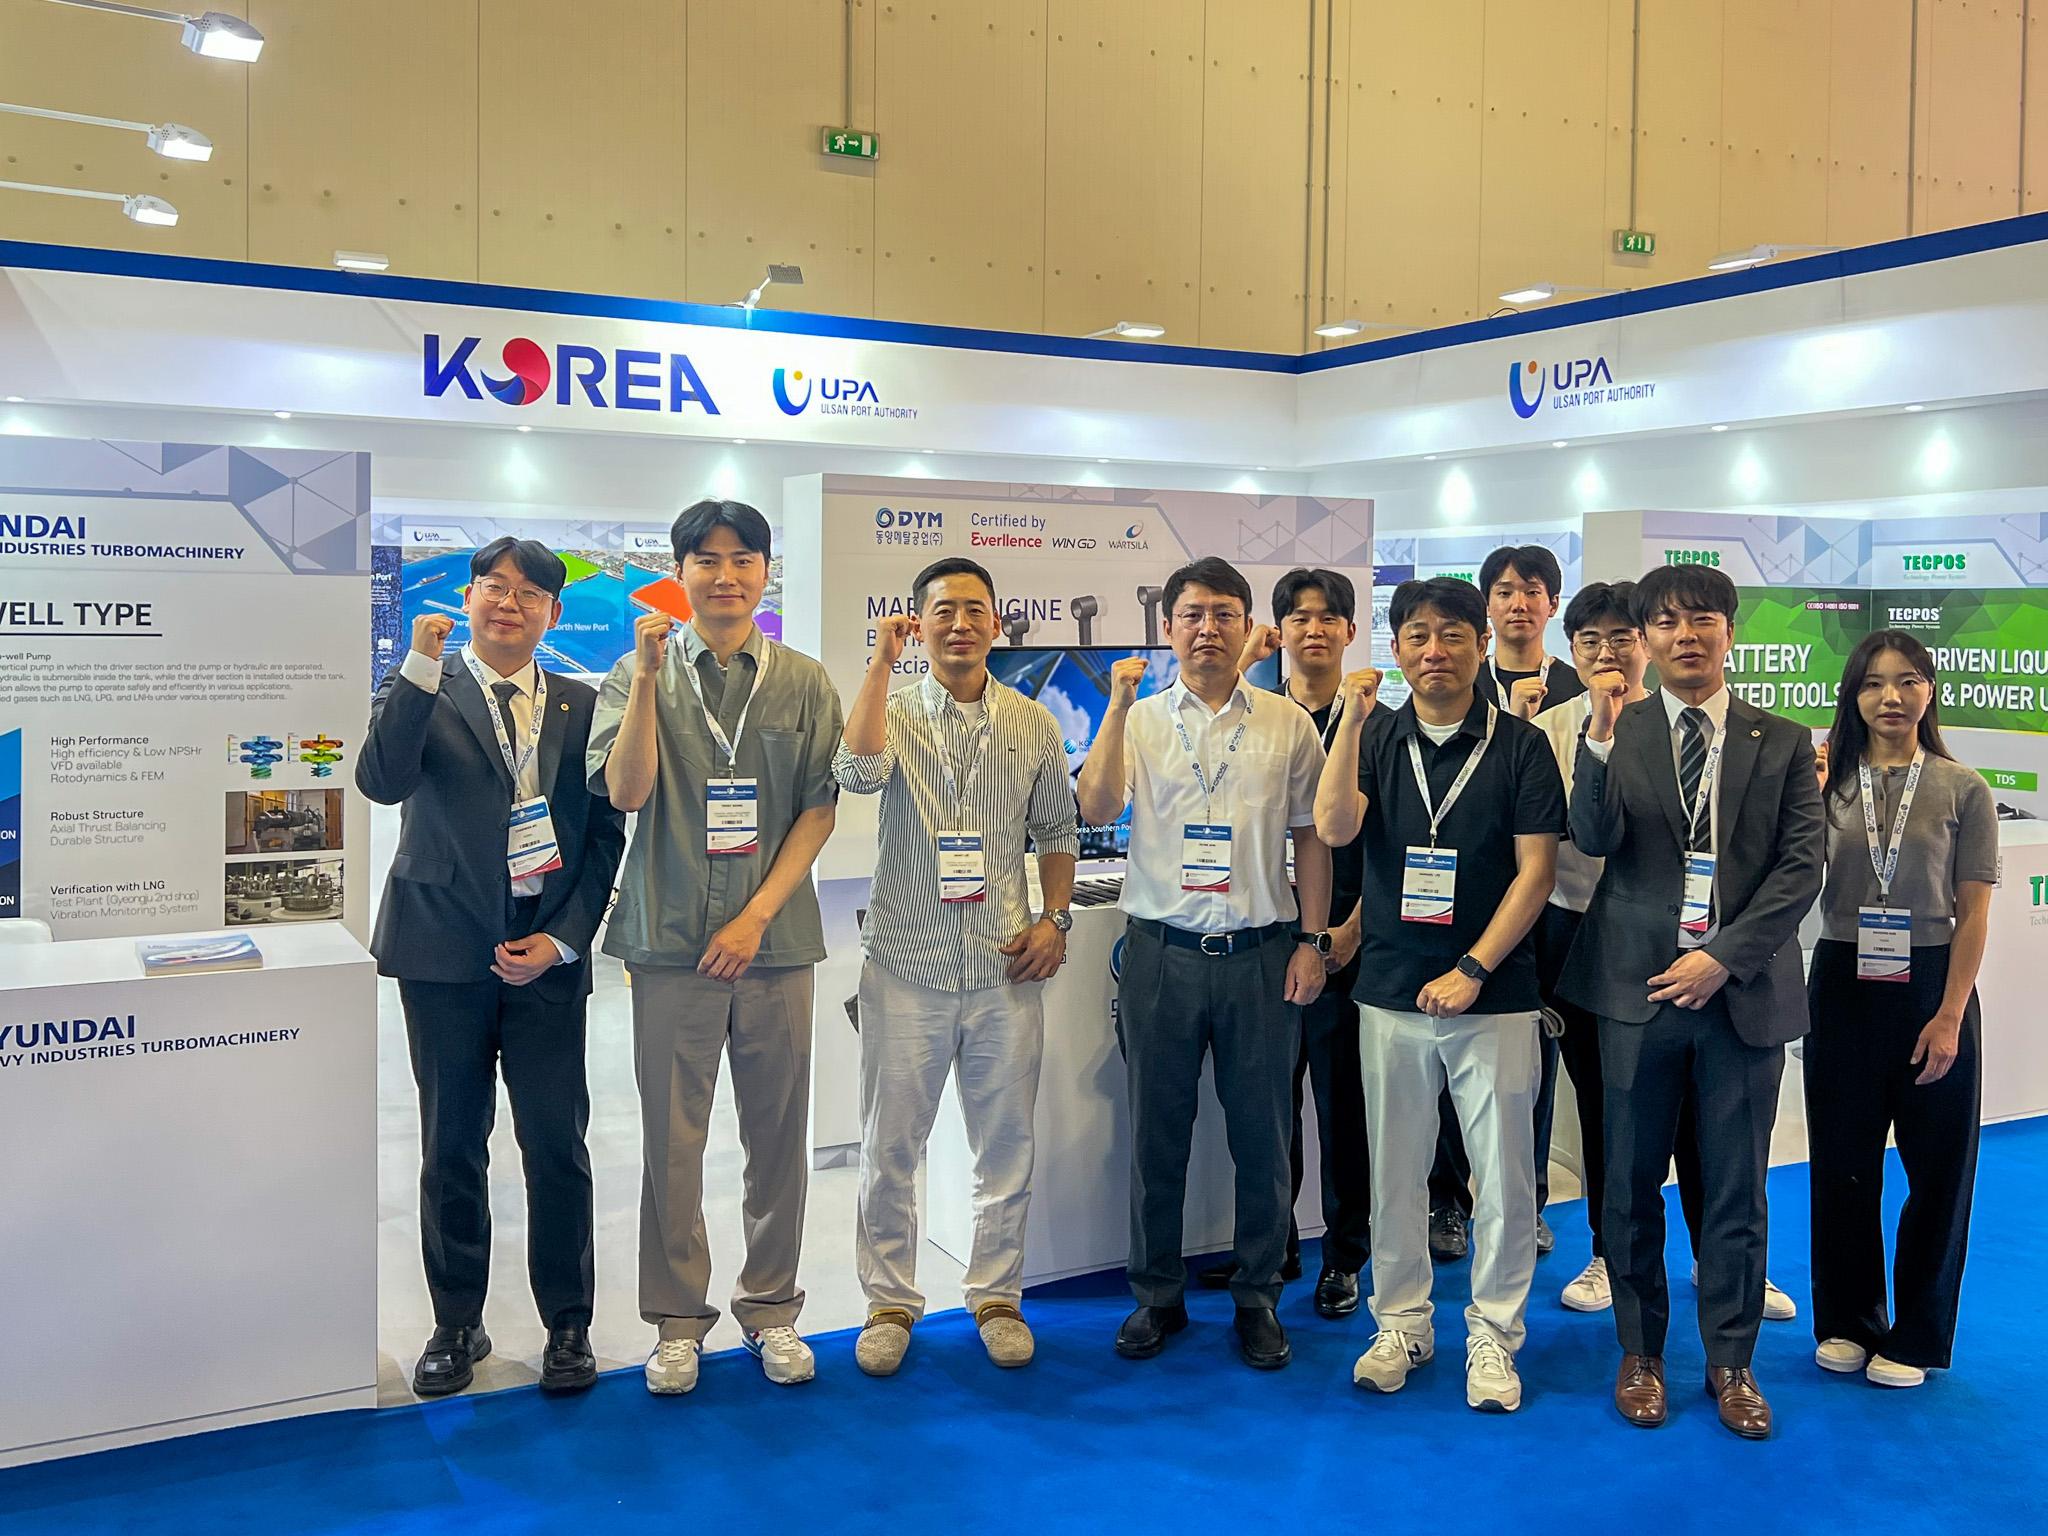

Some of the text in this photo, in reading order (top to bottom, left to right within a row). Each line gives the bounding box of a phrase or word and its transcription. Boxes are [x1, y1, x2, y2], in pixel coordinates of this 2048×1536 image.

[424, 334, 721, 415] KOREA
[1553, 356, 1613, 390] UPA
[821, 378, 879, 403] UPA
[1553, 383, 1656, 410] ULSAN PORT AUTHORITY
[821, 403, 918, 420] ULSAN PORT AUTHORITY
[898, 511, 943, 529] DYM
[971, 512, 1046, 532] Certified by
[876, 530, 943, 546] 동양메탈공업(주)
[971, 532, 1042, 548] Everllence
[0, 541, 245, 560] DUSTRIES TURBOMACHINERY
[1664, 549, 1720, 567] TECPOS
[1902, 554, 1966, 570] TECPOS
[73, 603, 152, 627] TYPE
[1888, 607, 1940, 621] TECPOS
[557, 623, 609, 632] orth New Port
[26, 652, 52, 662] Pump
[1723, 643, 1812, 673] ATTERY
[30, 663, 54, 671] pump
[66, 663, 91, 671] which
[94, 663, 108, 671] the
[110, 663, 133, 671] driver
[135, 663, 165, 671] section
[167, 663, 181, 671] and
[184, 662, 197, 671] the
[199, 662, 221, 671] pump
[224, 662, 231, 671] or
[233, 662, 268, 671] hydraulic
[93, 673, 116, 681] inside
[118, 673, 131, 681] the
[155, 673, 175, 681] while
[178, 672, 191, 681] the
[192, 672, 214, 681] driver
[216, 672, 243, 681] section
[253, 672, 284, 681] installed
[285, 672, 313, 680] outside
[315, 672, 326, 680] the
[14, 683, 41, 692] allows
[43, 683, 57, 692] the
[59, 683, 82, 692] pump
[84, 683, 93, 692] to
[95, 682, 125, 692] operate
[127, 682, 150, 692] safely
[152, 682, 167, 692] and
[169, 682, 206, 692] efficiently
[218, 682, 244, 691] various
[13, 693, 38, 703] gases
[40, 693, 60, 703] such
[116, 693, 131, 702] and
[155, 693, 177, 702] under
[180, 692, 207, 702] various
[209, 692, 244, 702] operating
[1941, 682, 1955, 707] &
[1960, 683, 2035, 711] POWER
[51, 735, 149, 748] High Performance
[51, 746, 203, 760] High efficiency & Low NPSHr
[51, 760, 122, 771] VFD available
[50, 771, 165, 784] Rotodynamics & FEM
[1995, 773, 2016, 785] TDS
[50, 810, 144, 821] Robust Structure
[50, 821, 167, 834] Axial Thrust Balancing
[1075, 826, 1090, 834] orea
[1091, 824, 1120, 833] Southern
[50, 834, 144, 846] Durable Structure
[50, 880, 165, 895] Verification with LNG
[51, 896, 72, 908] Test
[76, 895, 103, 906] Plant
[50, 903, 199, 920] Vibration Monitoring System
[31, 1043, 135, 1065] INDUSTRIES
[142, 1028, 301, 1053] TURBOMACHINERY
